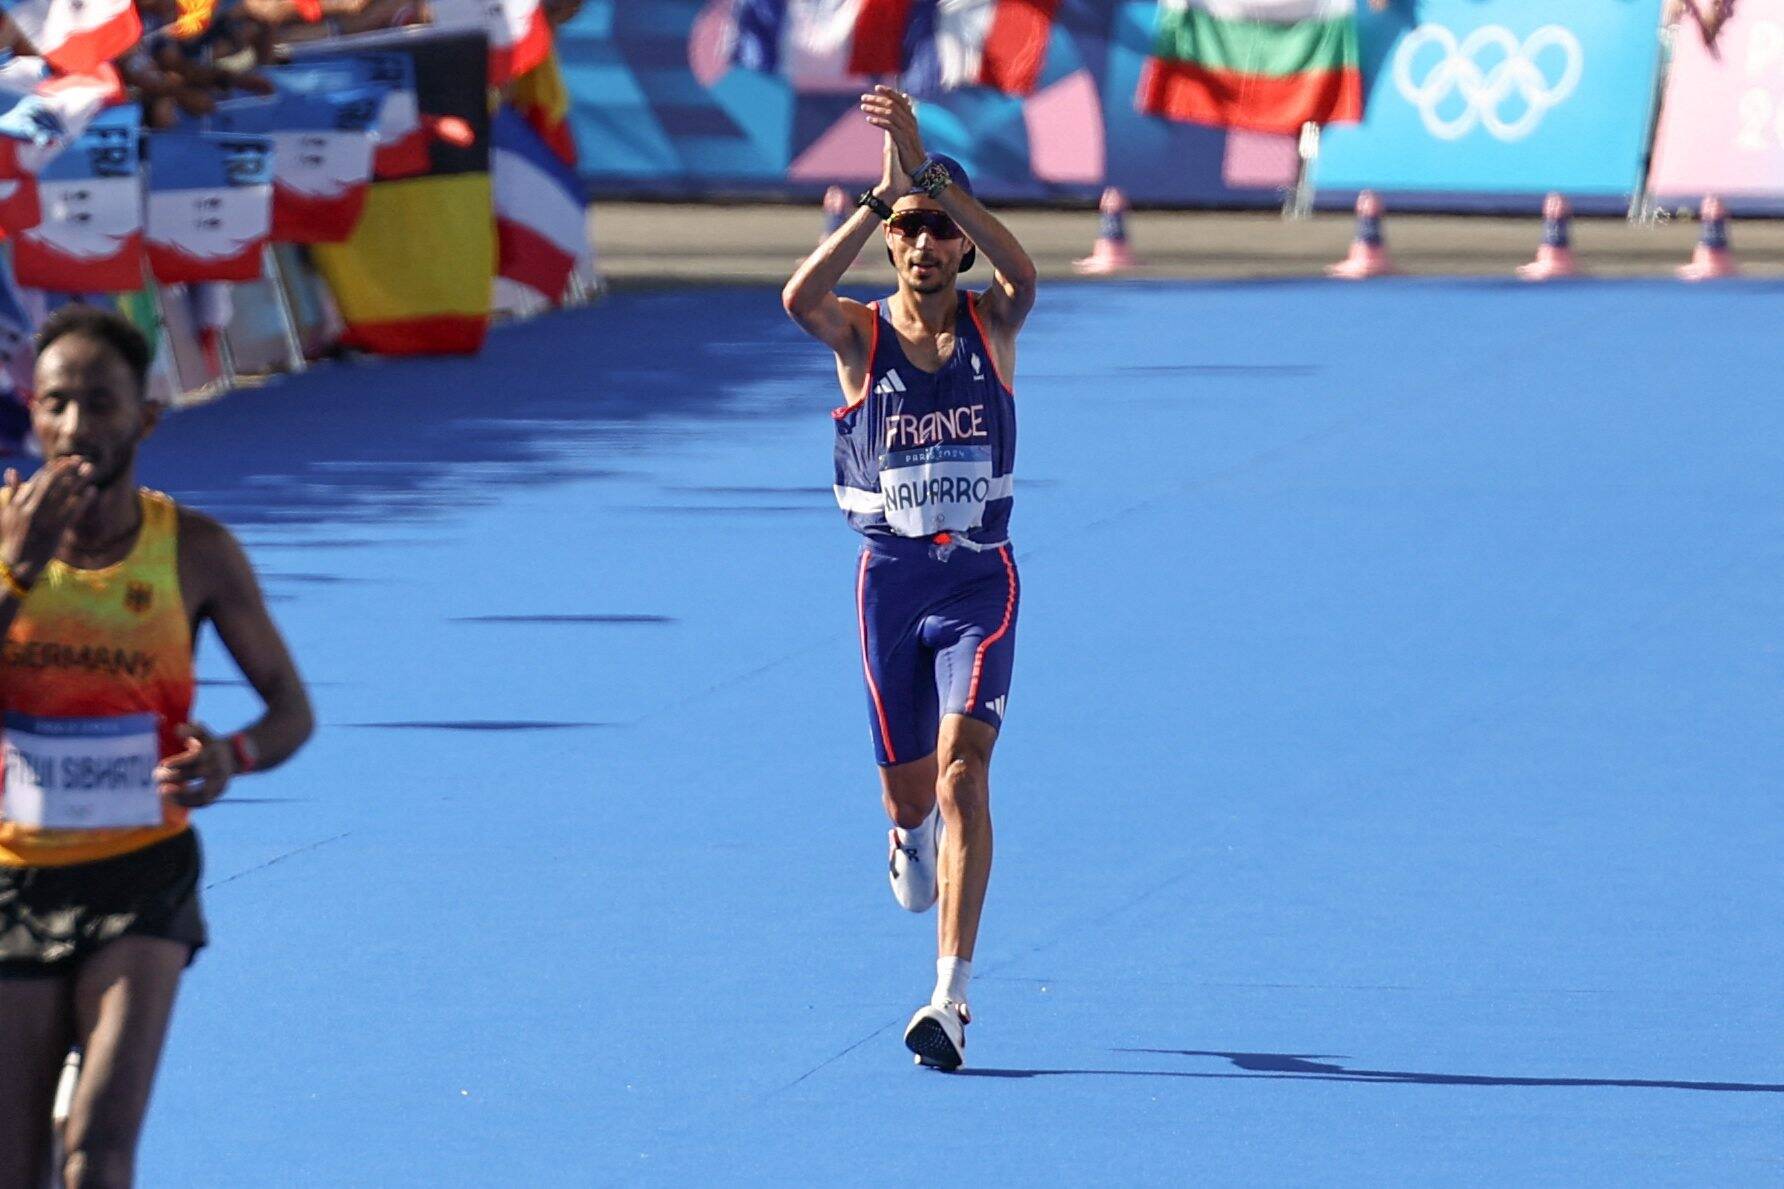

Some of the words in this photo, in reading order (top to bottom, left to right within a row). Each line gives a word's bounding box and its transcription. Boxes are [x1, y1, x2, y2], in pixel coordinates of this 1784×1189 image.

[886, 404, 987, 449] FRANCE
[884, 476, 989, 512] NAVARRO
[8, 641, 156, 679] GERMANY
